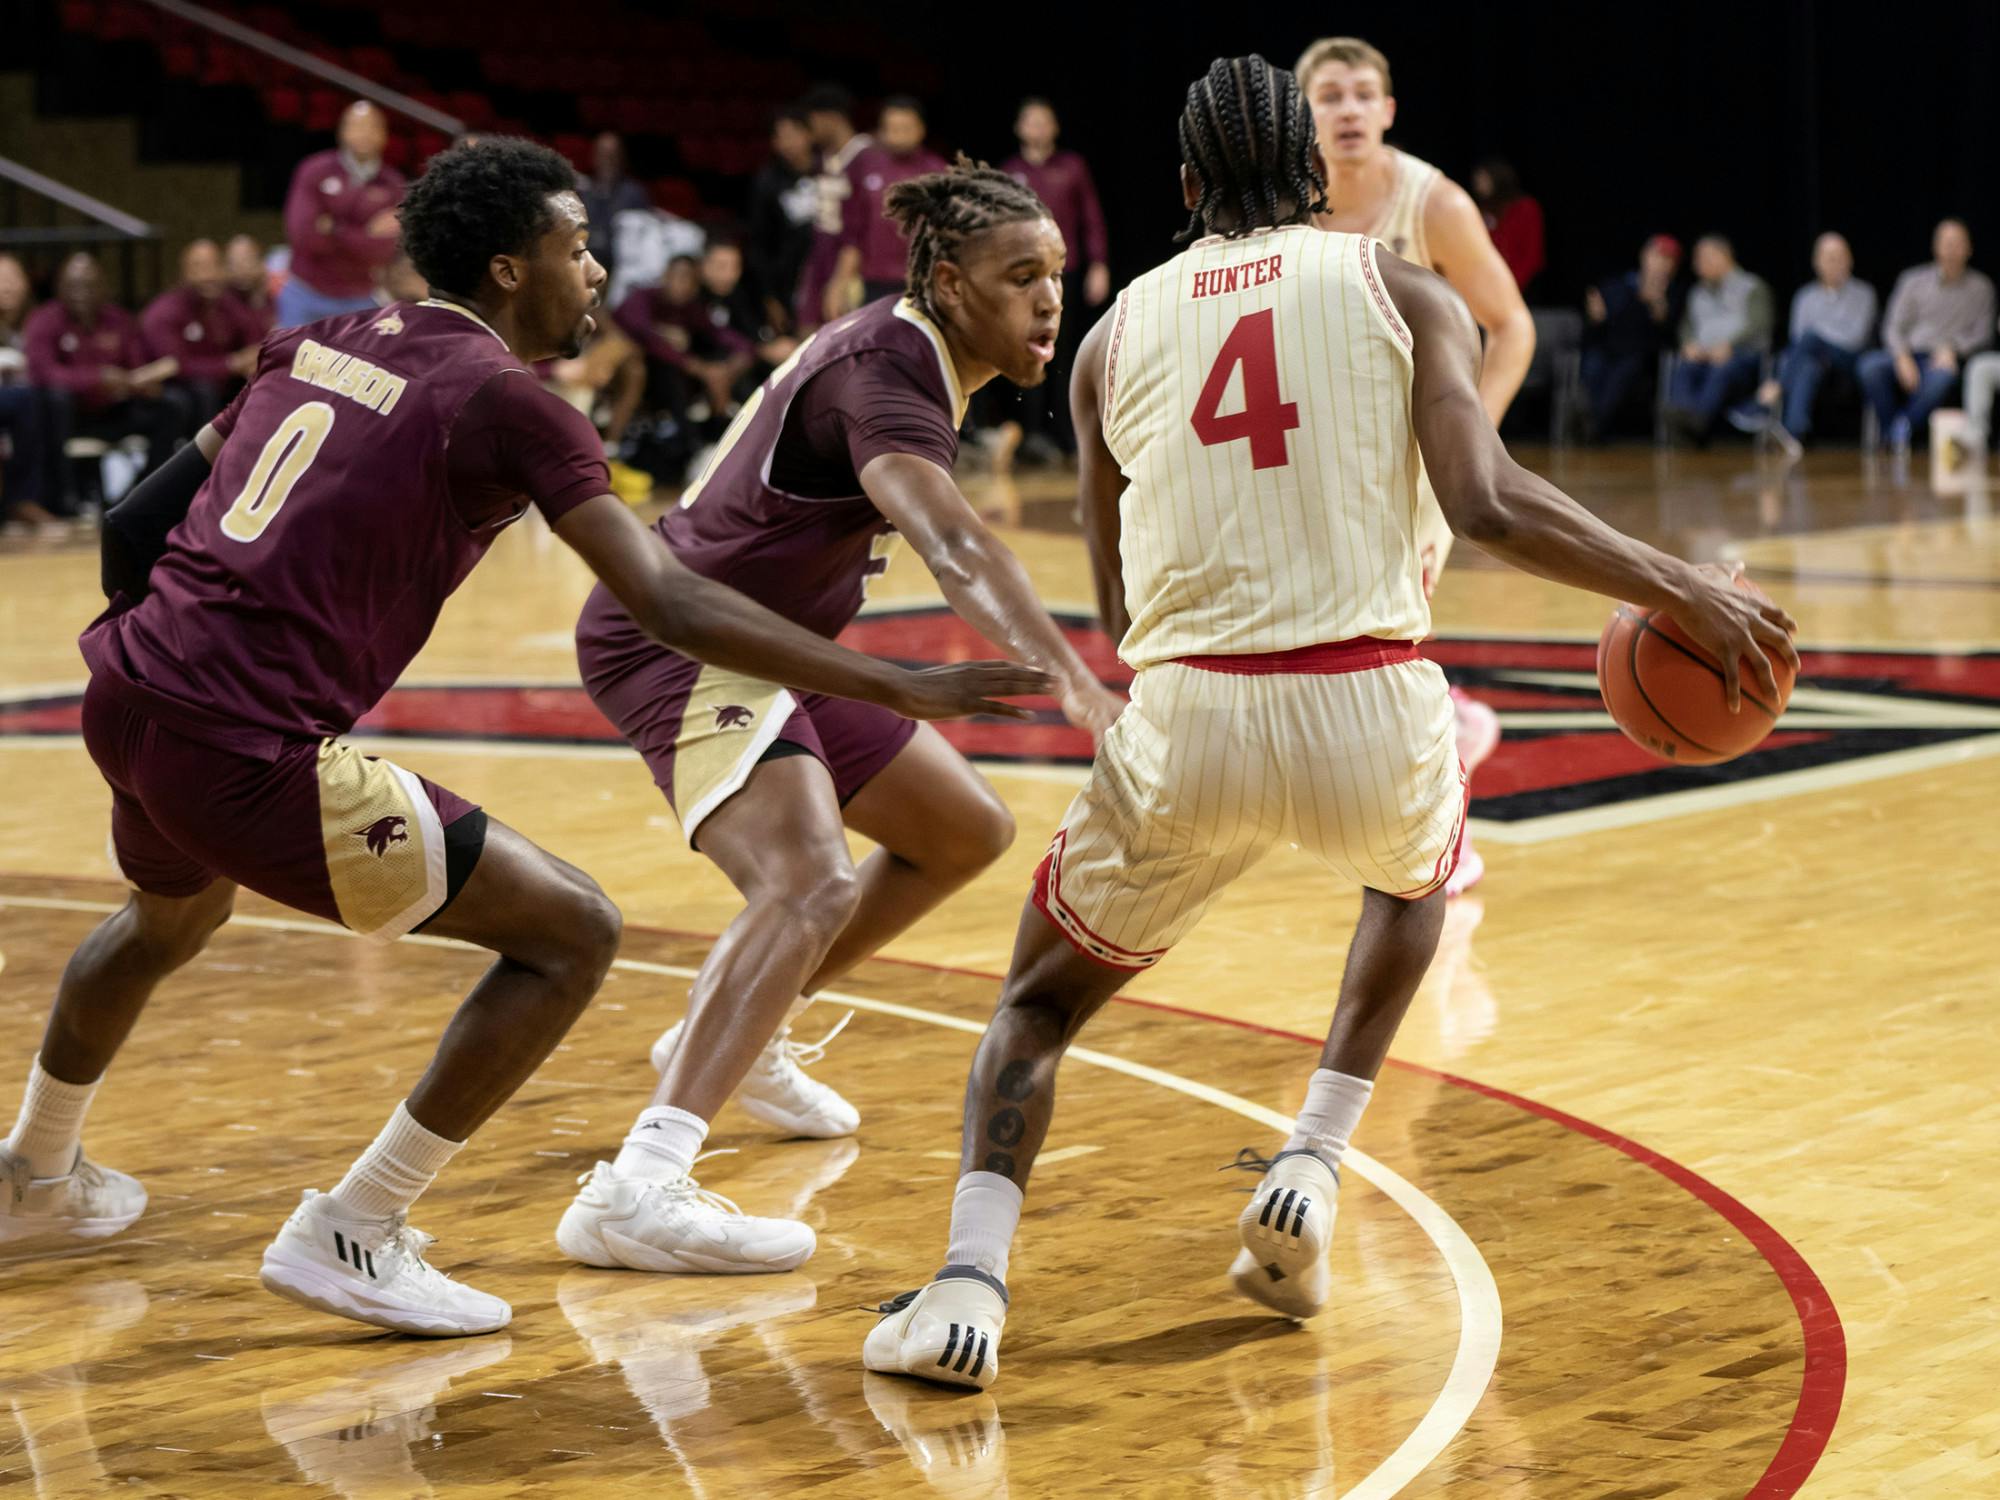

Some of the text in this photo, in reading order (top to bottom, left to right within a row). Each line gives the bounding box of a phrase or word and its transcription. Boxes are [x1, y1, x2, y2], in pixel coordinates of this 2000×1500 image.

[1191, 254, 1283, 299] HUNTER
[290, 338, 408, 416] DAWSON
[1190, 307, 1300, 470] 4
[220, 401, 335, 543] 0
